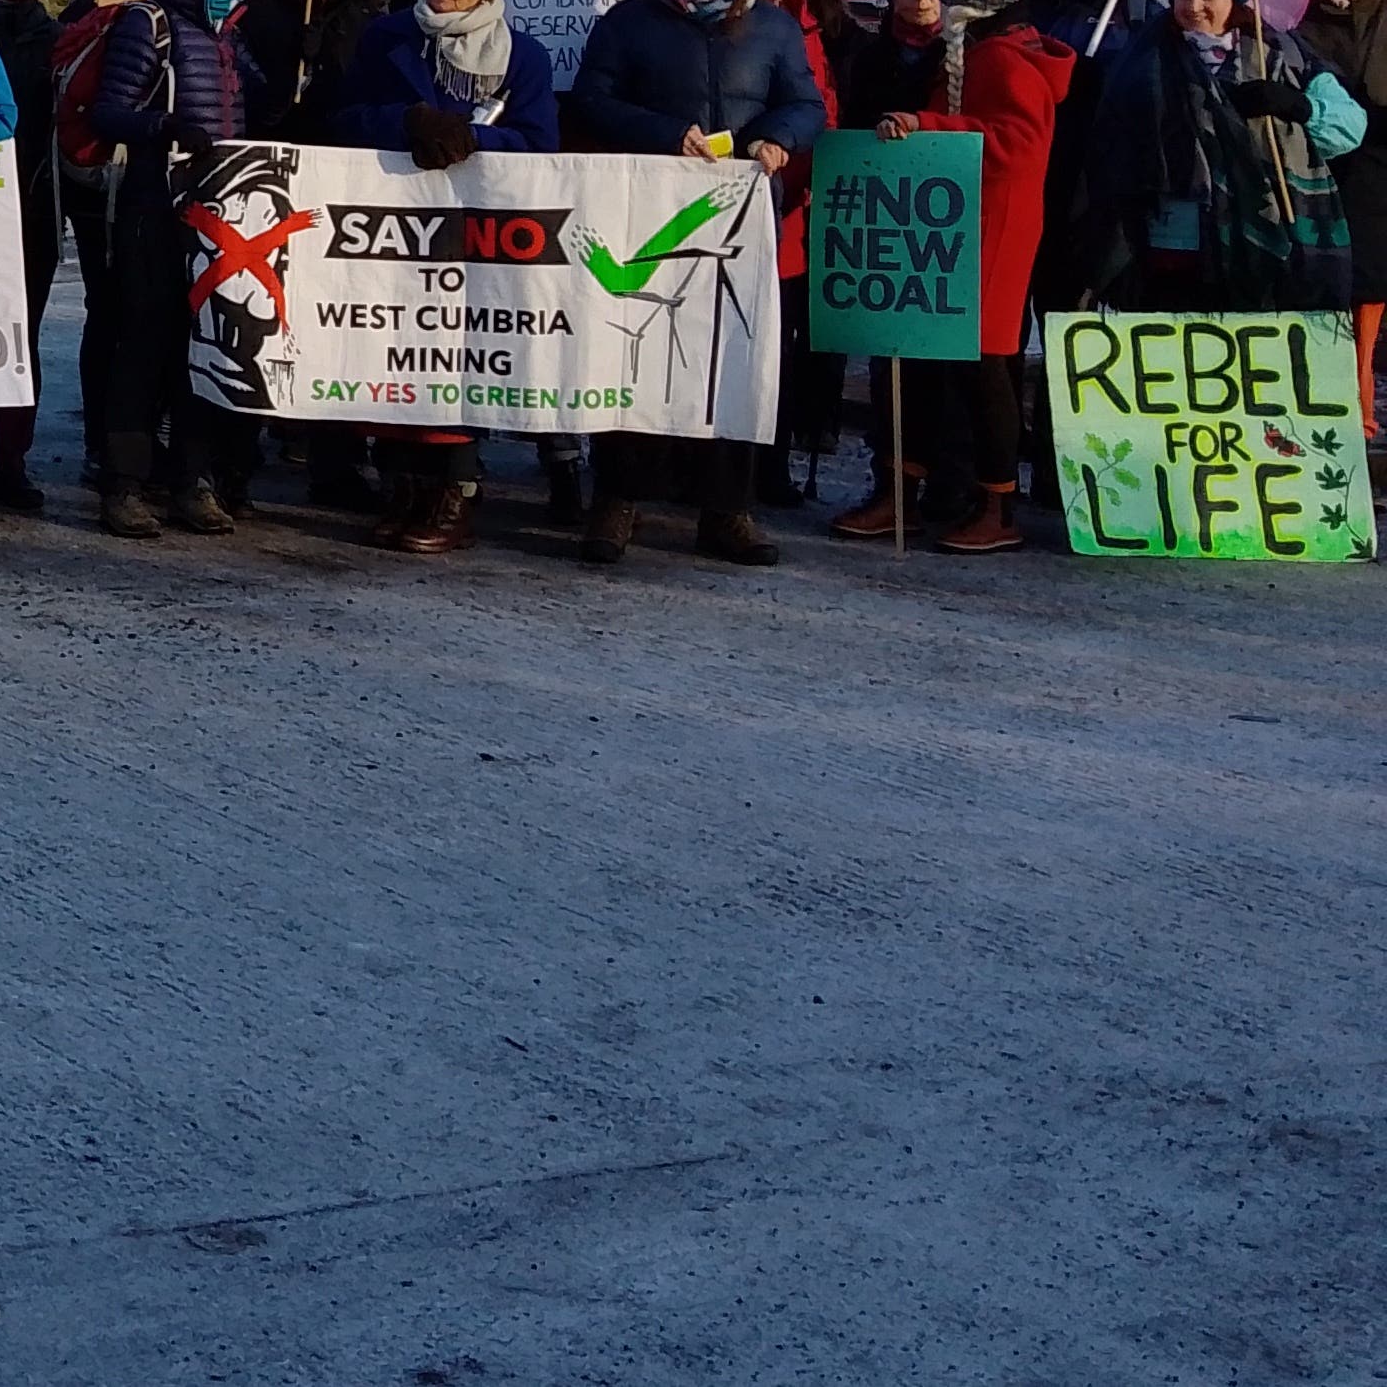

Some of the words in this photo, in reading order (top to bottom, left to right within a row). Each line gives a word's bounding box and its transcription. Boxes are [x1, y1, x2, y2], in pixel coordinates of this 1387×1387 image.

[823, 174, 967, 229] #NO
[337, 213, 446, 257] SAY
[465, 217, 546, 259] NO
[824, 227, 968, 273] NEW
[418, 268, 465, 293] TO
[821, 272, 967, 316] COAL
[315, 302, 407, 331] WEST
[414, 306, 575, 337] CUMBRIA
[386, 345, 513, 377] MINING
[1063, 320, 1350, 418] REBEL
[310, 379, 362, 402] SAY
[367, 381, 418, 406] YES
[426, 383, 460, 406] TO
[466, 384, 559, 409] GREEN
[566, 386, 635, 410] JOBS
[1164, 421, 1251, 464] FOR
[1080, 462, 1305, 555] LIFE
